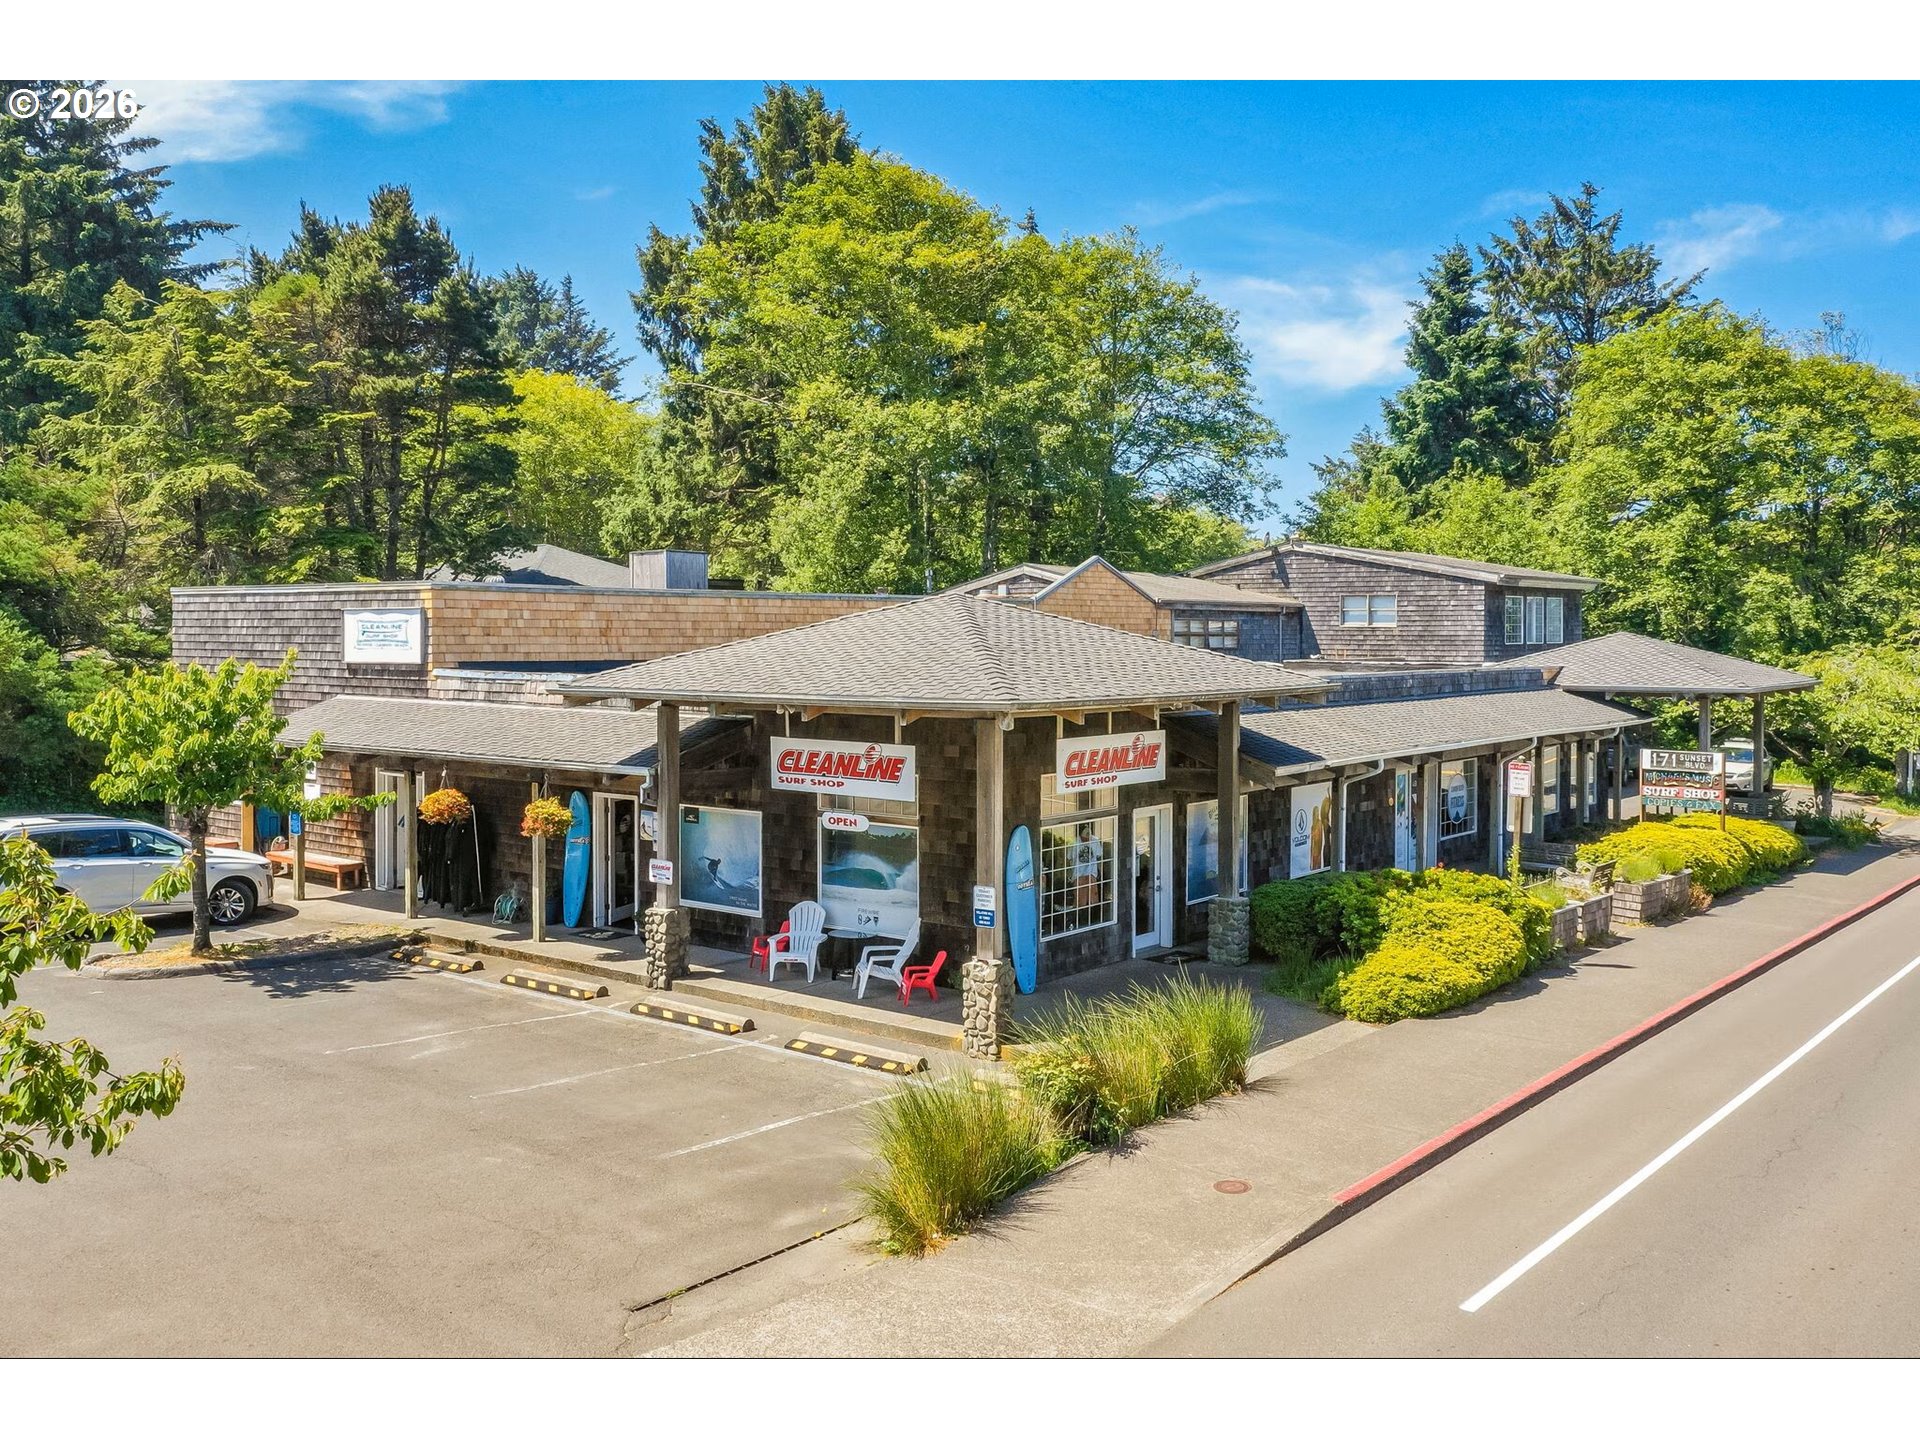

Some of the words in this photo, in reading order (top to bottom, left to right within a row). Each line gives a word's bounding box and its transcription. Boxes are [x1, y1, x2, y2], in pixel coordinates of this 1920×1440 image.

[1064, 734, 1162, 778] CLEANLINE
[1652, 752, 1677, 768] 171
[1680, 753, 1712, 763] SUNSET
[777, 743, 907, 783] CLEANLINE
[778, 776, 806, 785] SURF
[810, 778, 845, 788] SHOP
[1065, 780, 1088, 789] SURF
[1091, 775, 1118, 785] SHOP
[1643, 787, 1678, 797] SURF
[1684, 789, 1719, 800] SHOP
[1647, 798, 1684, 807] COPIES
[1695, 801, 1716, 809] FAX
[828, 817, 858, 827] OPEN
